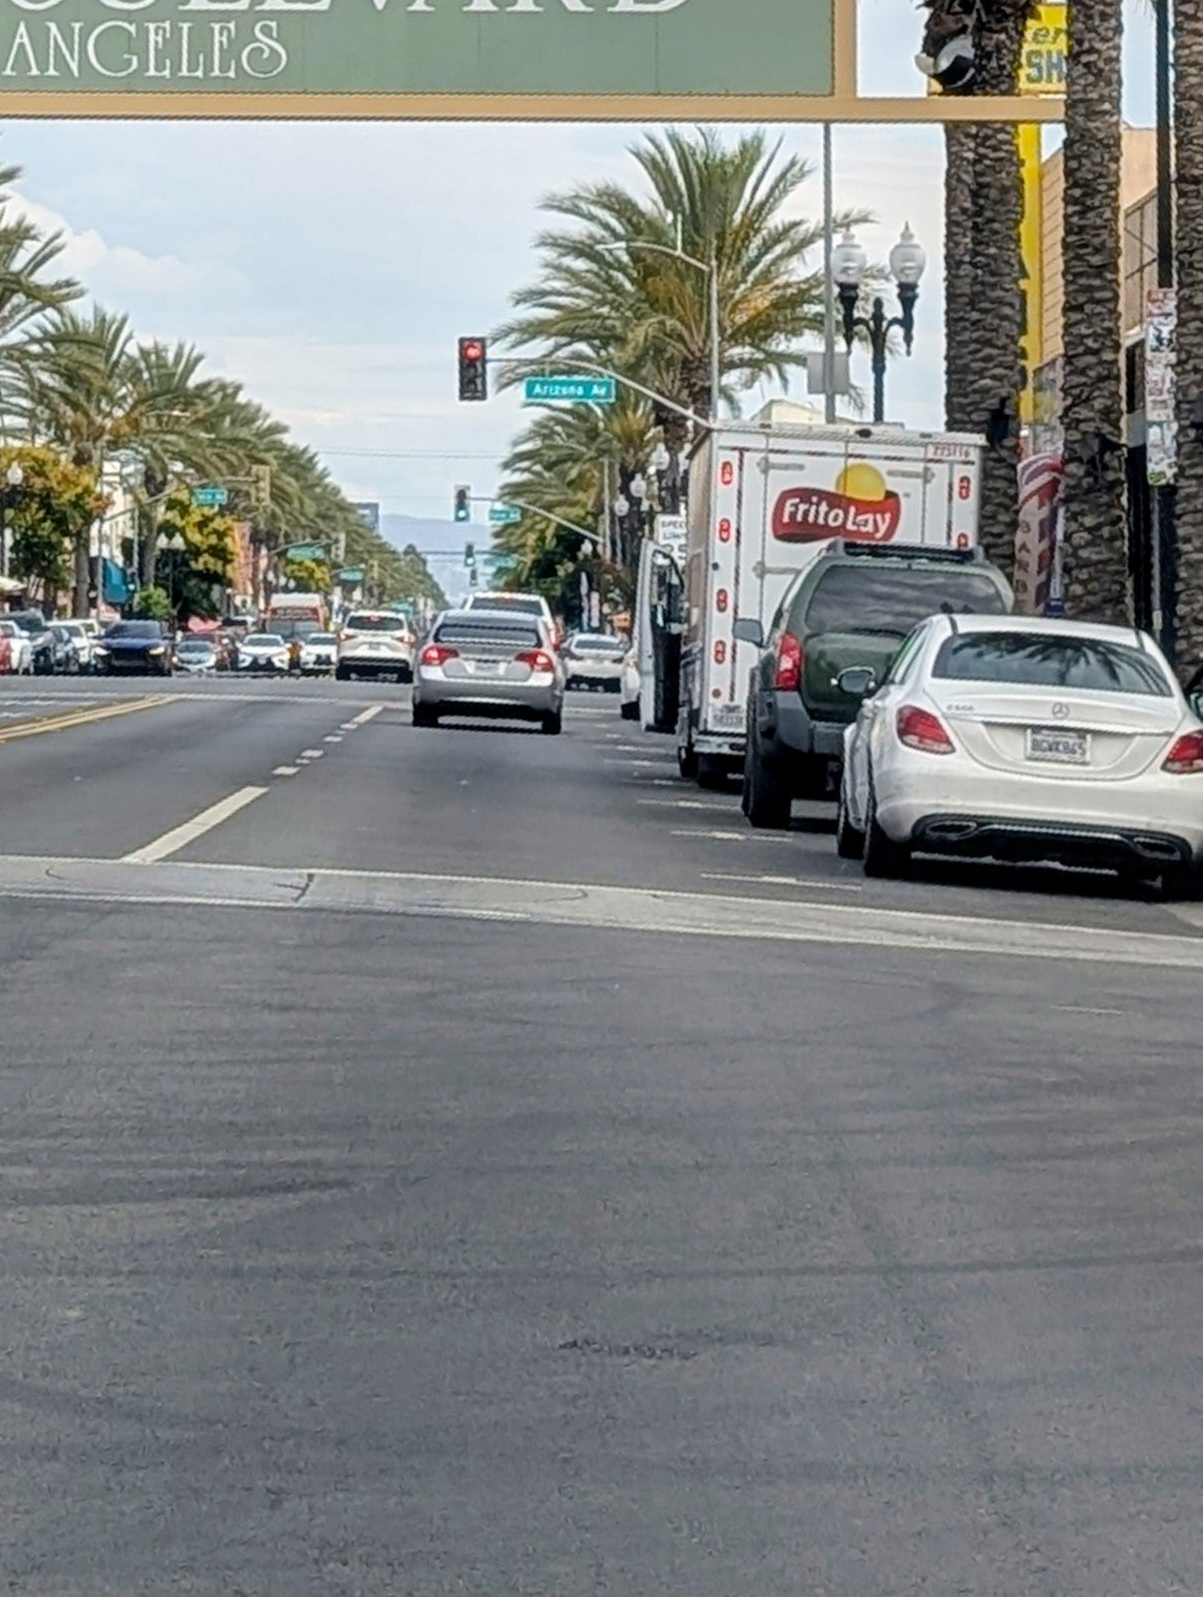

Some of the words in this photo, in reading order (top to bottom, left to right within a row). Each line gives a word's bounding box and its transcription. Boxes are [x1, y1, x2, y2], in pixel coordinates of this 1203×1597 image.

[1, 19, 289, 79] ANGELES
[533, 383, 584, 395] Arizona
[782, 496, 845, 527] Frito
[846, 505, 891, 539] Lay
